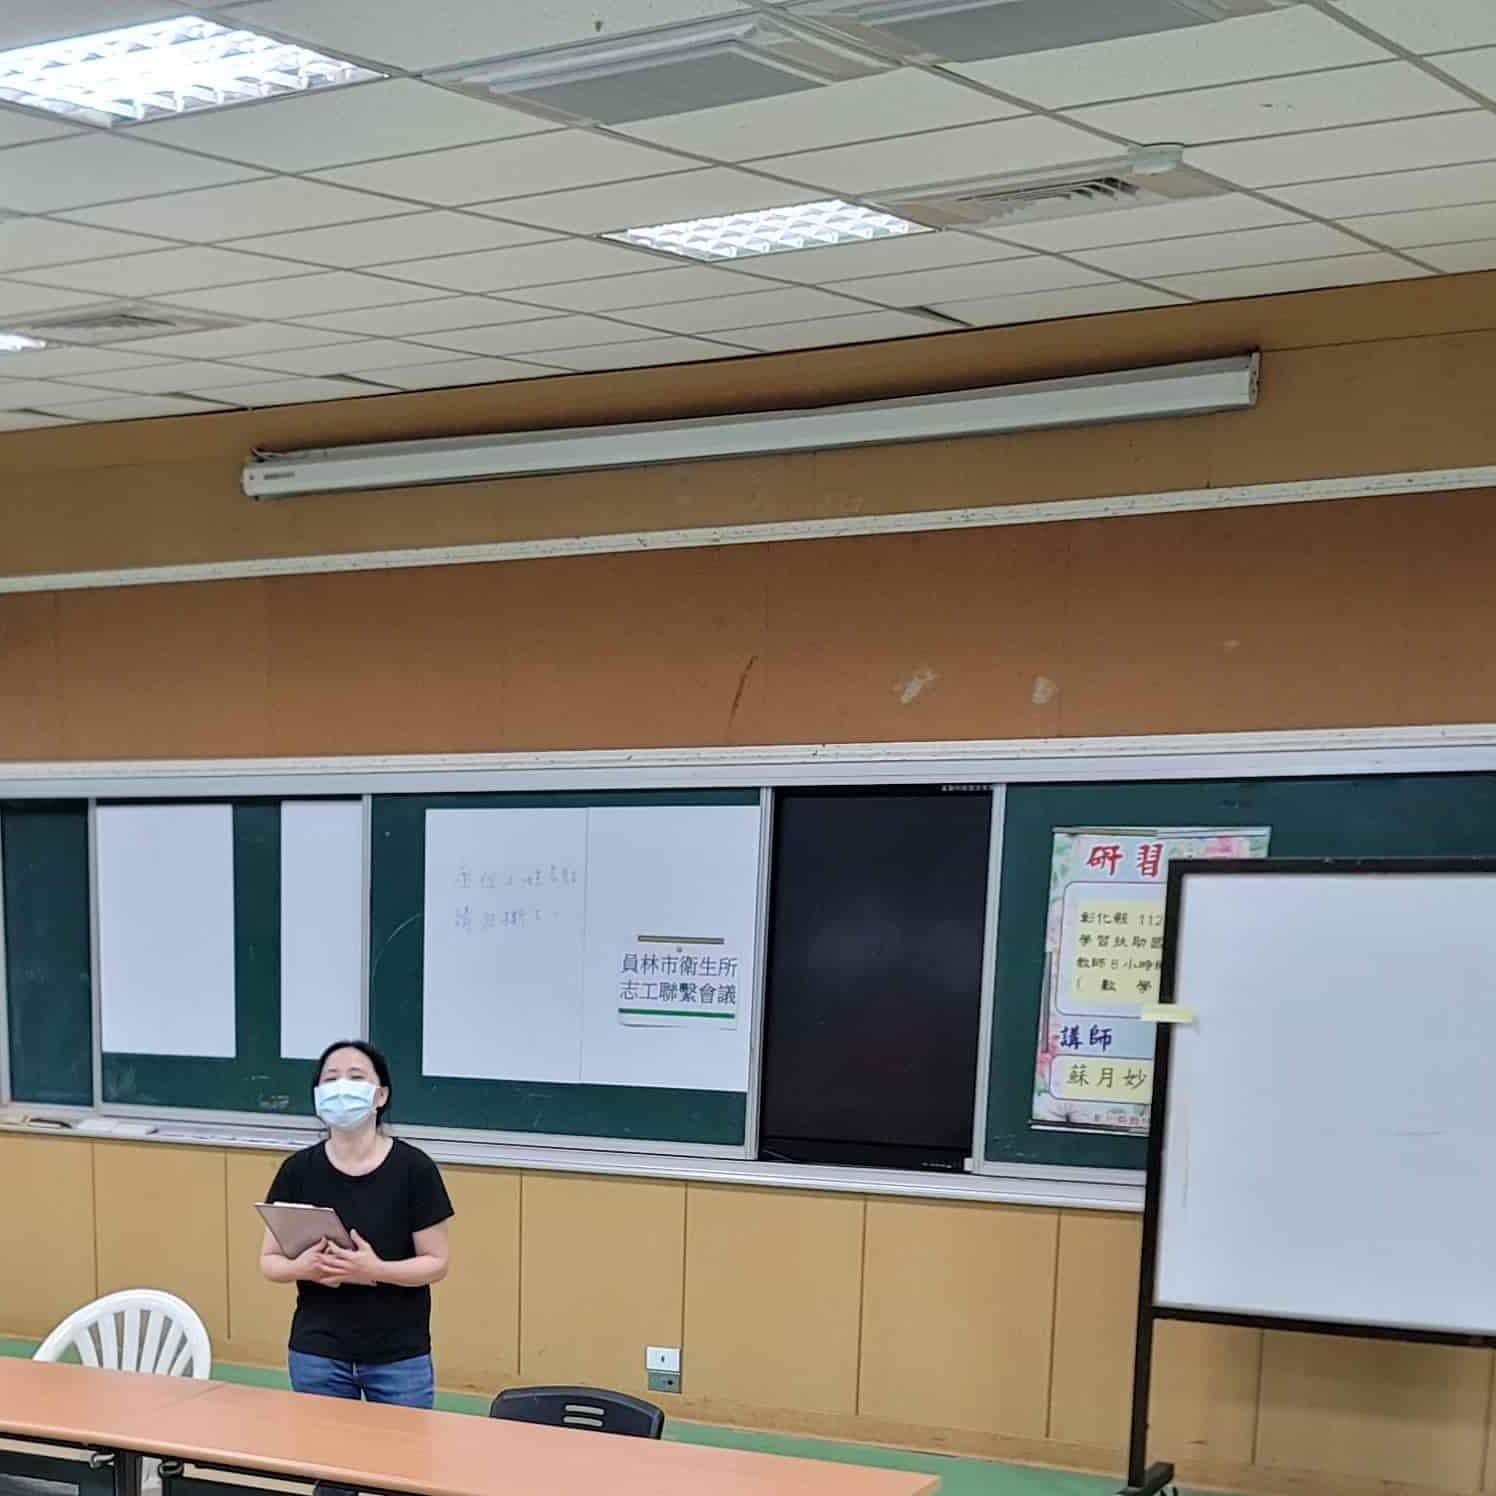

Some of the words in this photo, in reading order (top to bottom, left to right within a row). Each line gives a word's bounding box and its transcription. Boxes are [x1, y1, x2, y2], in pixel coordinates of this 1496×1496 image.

[622, 953, 739, 978] 員林市衛生所
[619, 980, 737, 1004] 志工聯繫會議
[1060, 1024, 1113, 1053] 講師
